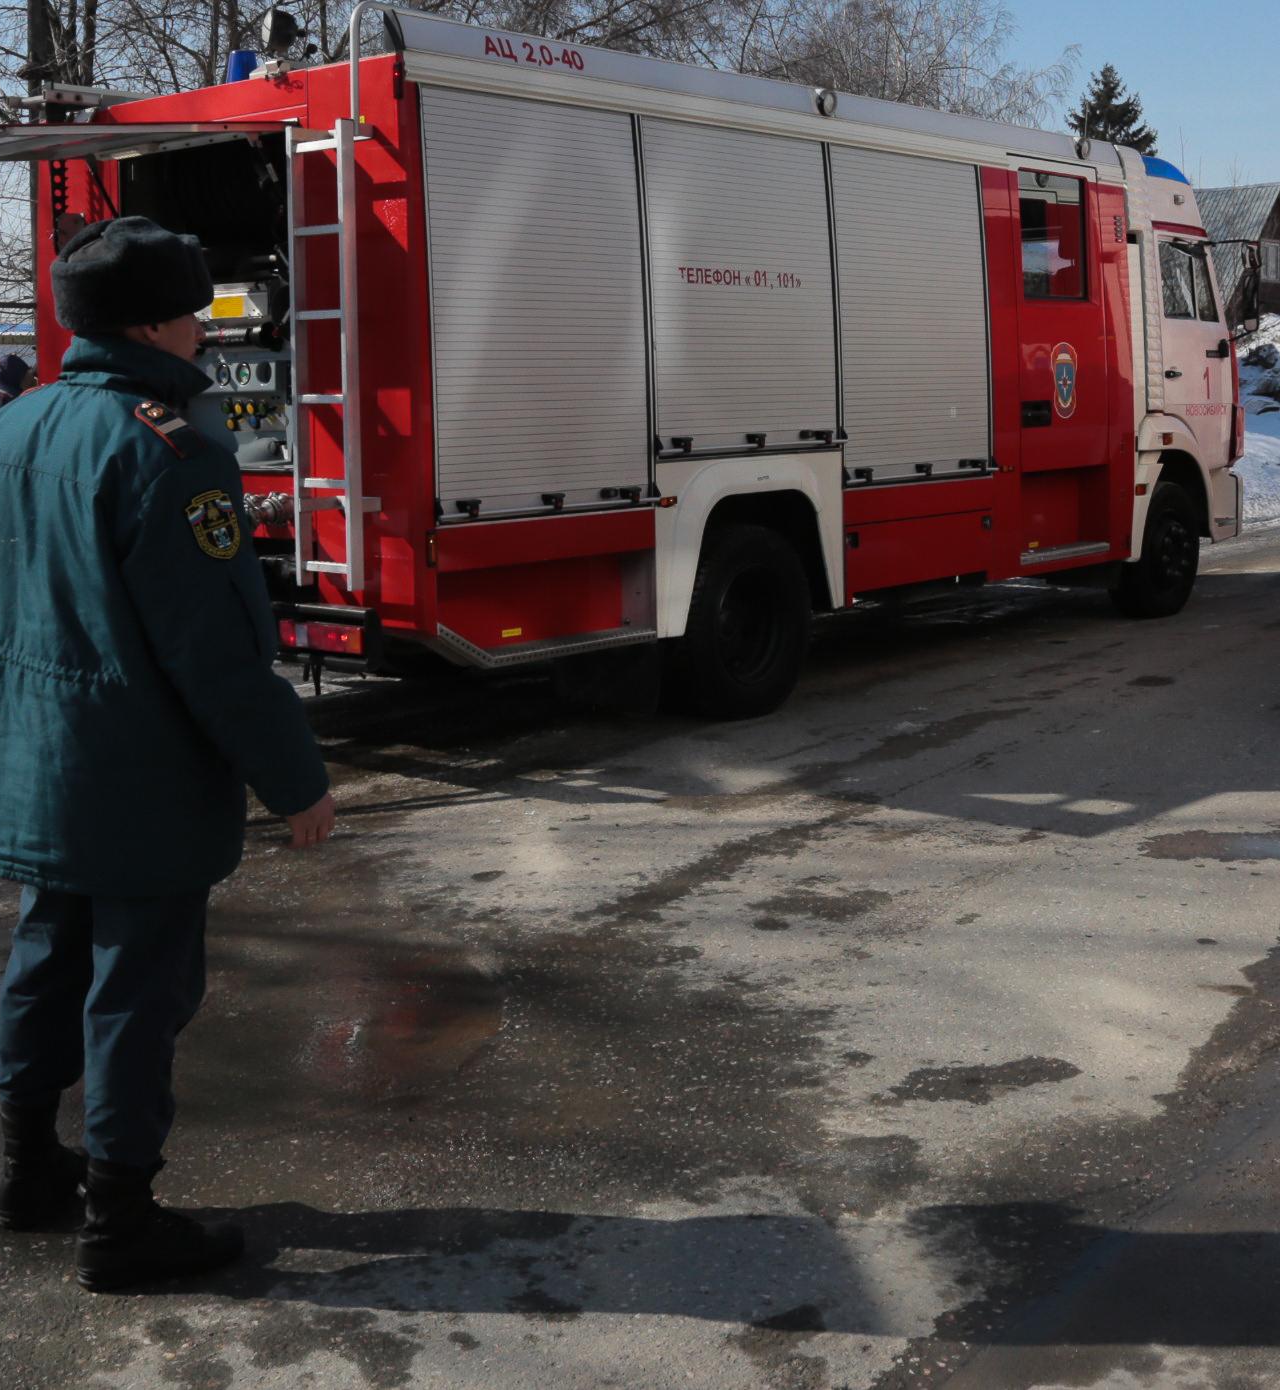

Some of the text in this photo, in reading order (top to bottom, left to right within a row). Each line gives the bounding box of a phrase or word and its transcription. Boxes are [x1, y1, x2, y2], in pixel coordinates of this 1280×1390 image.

[485, 35, 584, 70] АЦ 2,0-40
[678, 267, 740, 286] ТЕЛЕФОН
[1203, 366, 1210, 399] 1
